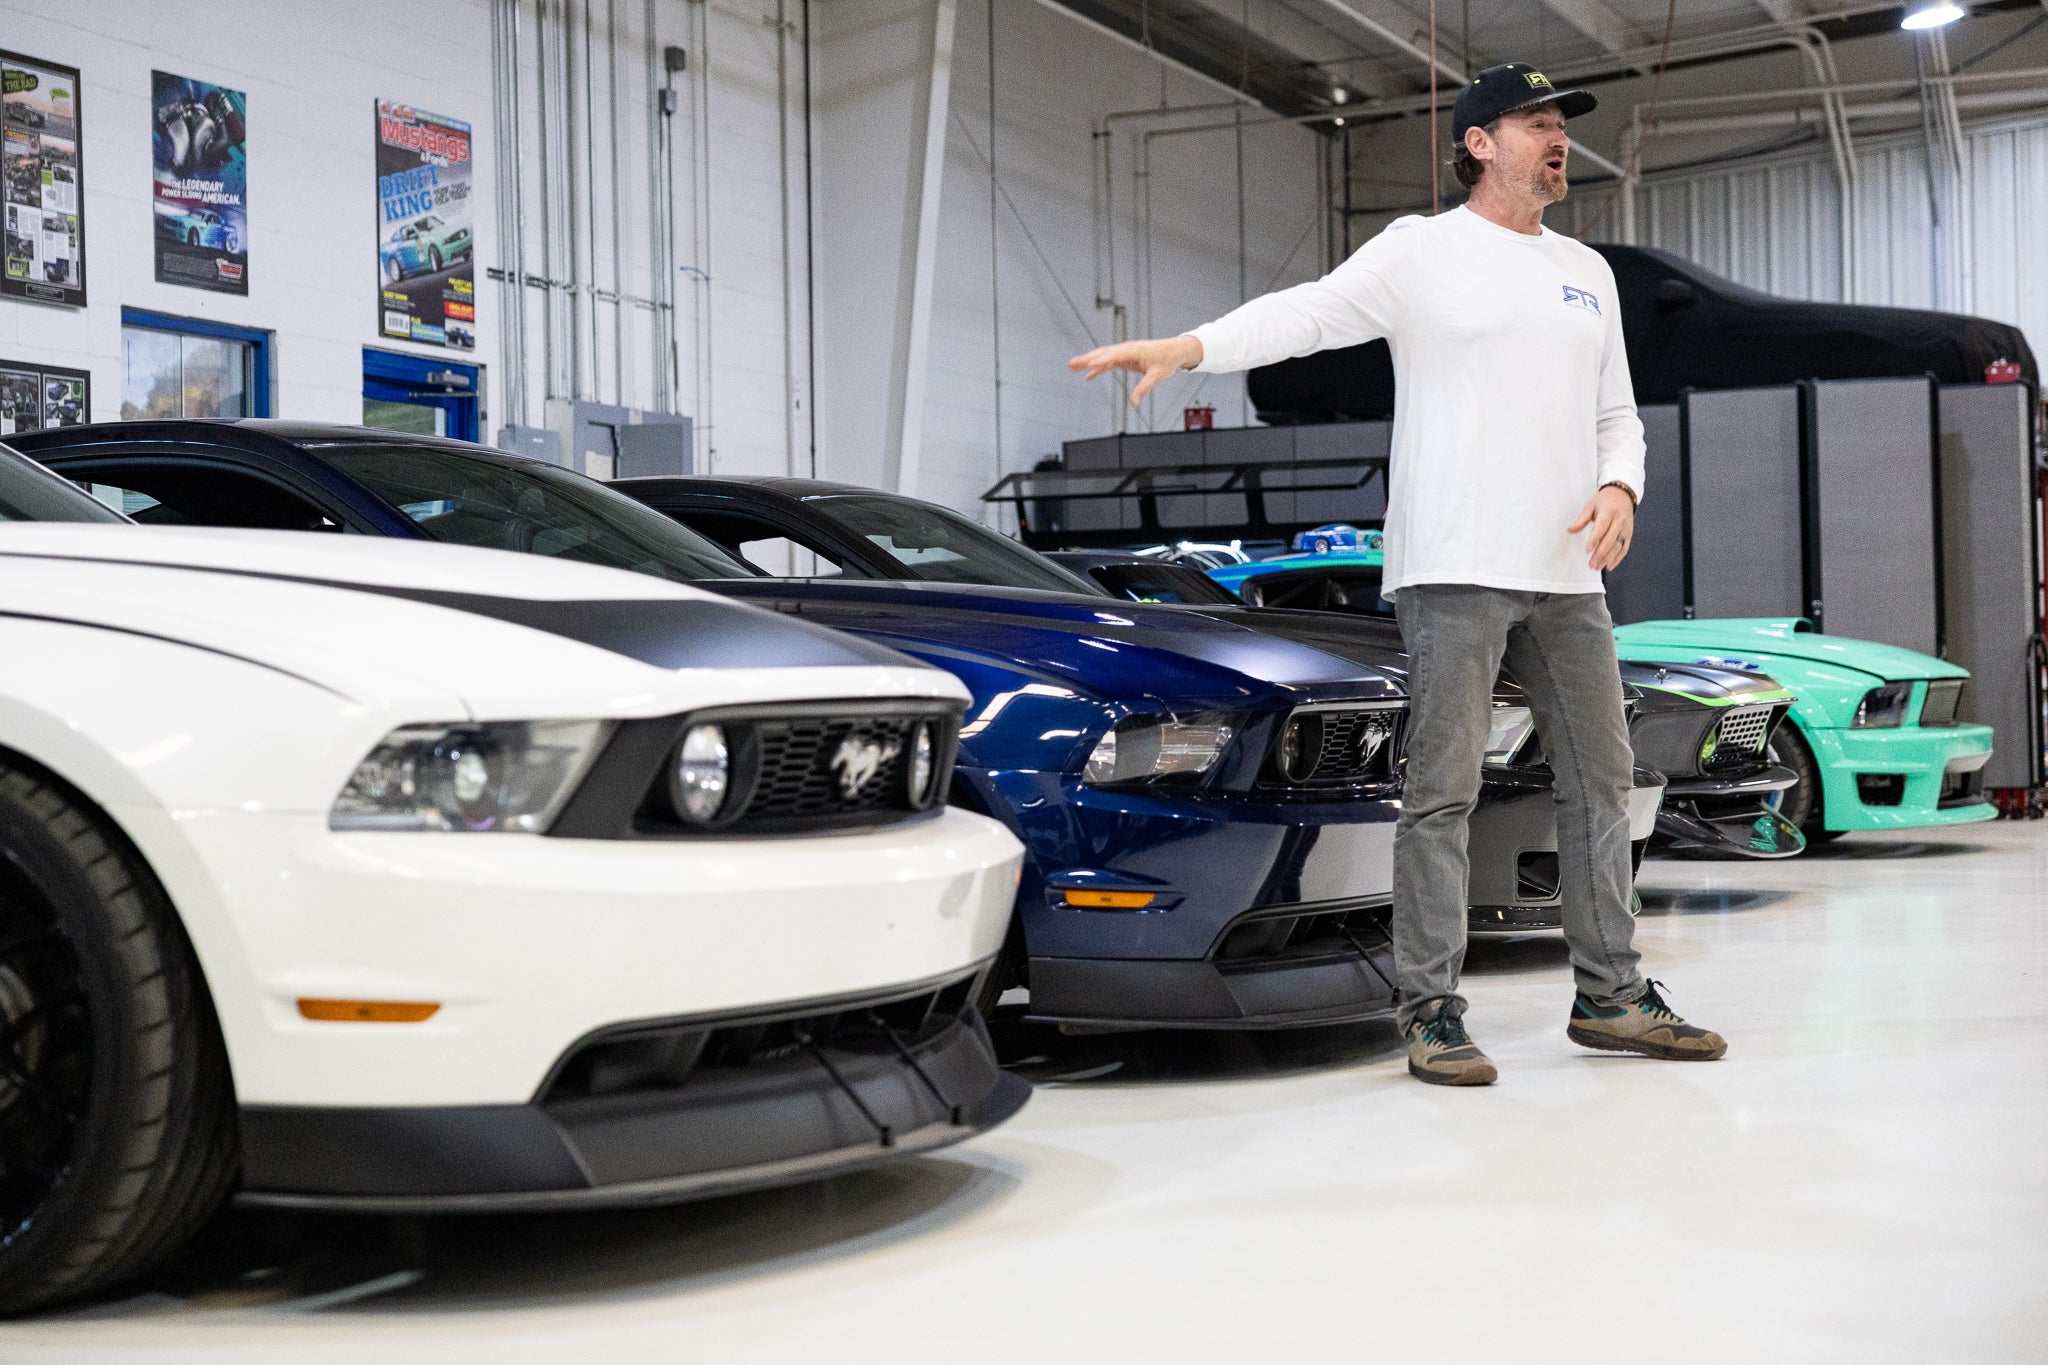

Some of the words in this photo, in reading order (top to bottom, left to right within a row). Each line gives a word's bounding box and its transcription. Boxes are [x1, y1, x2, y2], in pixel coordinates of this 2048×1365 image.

[381, 117, 469, 163] Mustangs
[161, 188, 181, 197] POWER
[182, 178, 224, 193] LEGENDARY
[379, 165, 438, 199] DRIFT
[384, 190, 433, 222] KING
